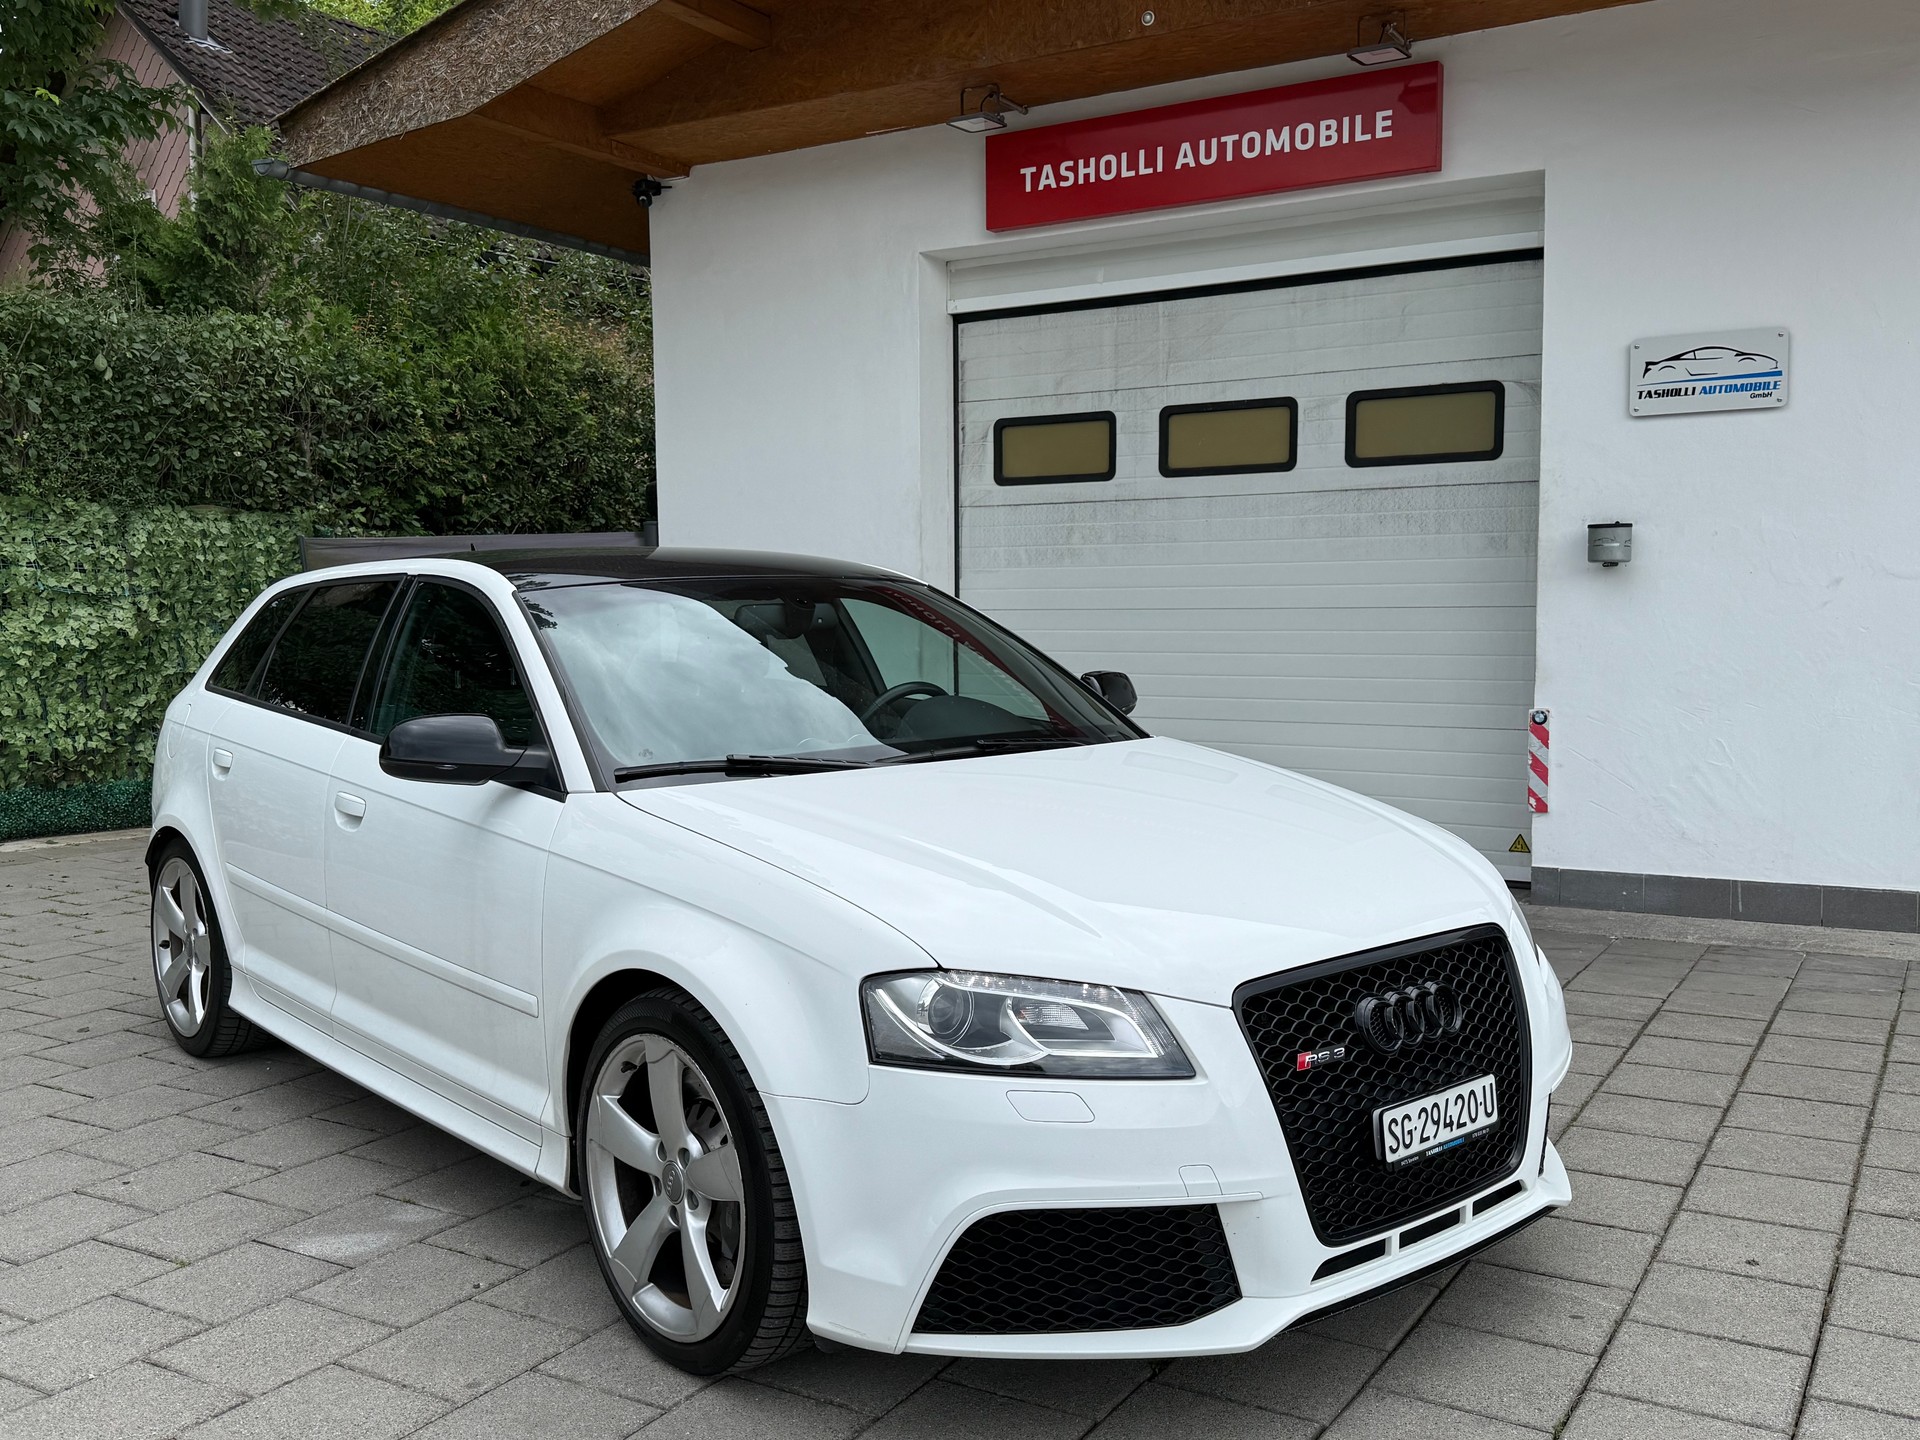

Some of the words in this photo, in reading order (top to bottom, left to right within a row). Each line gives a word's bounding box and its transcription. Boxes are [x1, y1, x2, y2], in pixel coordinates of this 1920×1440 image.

[1020, 146, 1163, 193] TASHOLLI
[1175, 109, 1393, 170] AUTOMOBILE
[1637, 386, 1697, 400] TASHOLLI
[1699, 380, 1782, 396] AUTOMOBILE
[1749, 391, 1773, 399] GmbH
[1305, 1051, 1330, 1068] RS
[1333, 1047, 1345, 1059] 3
